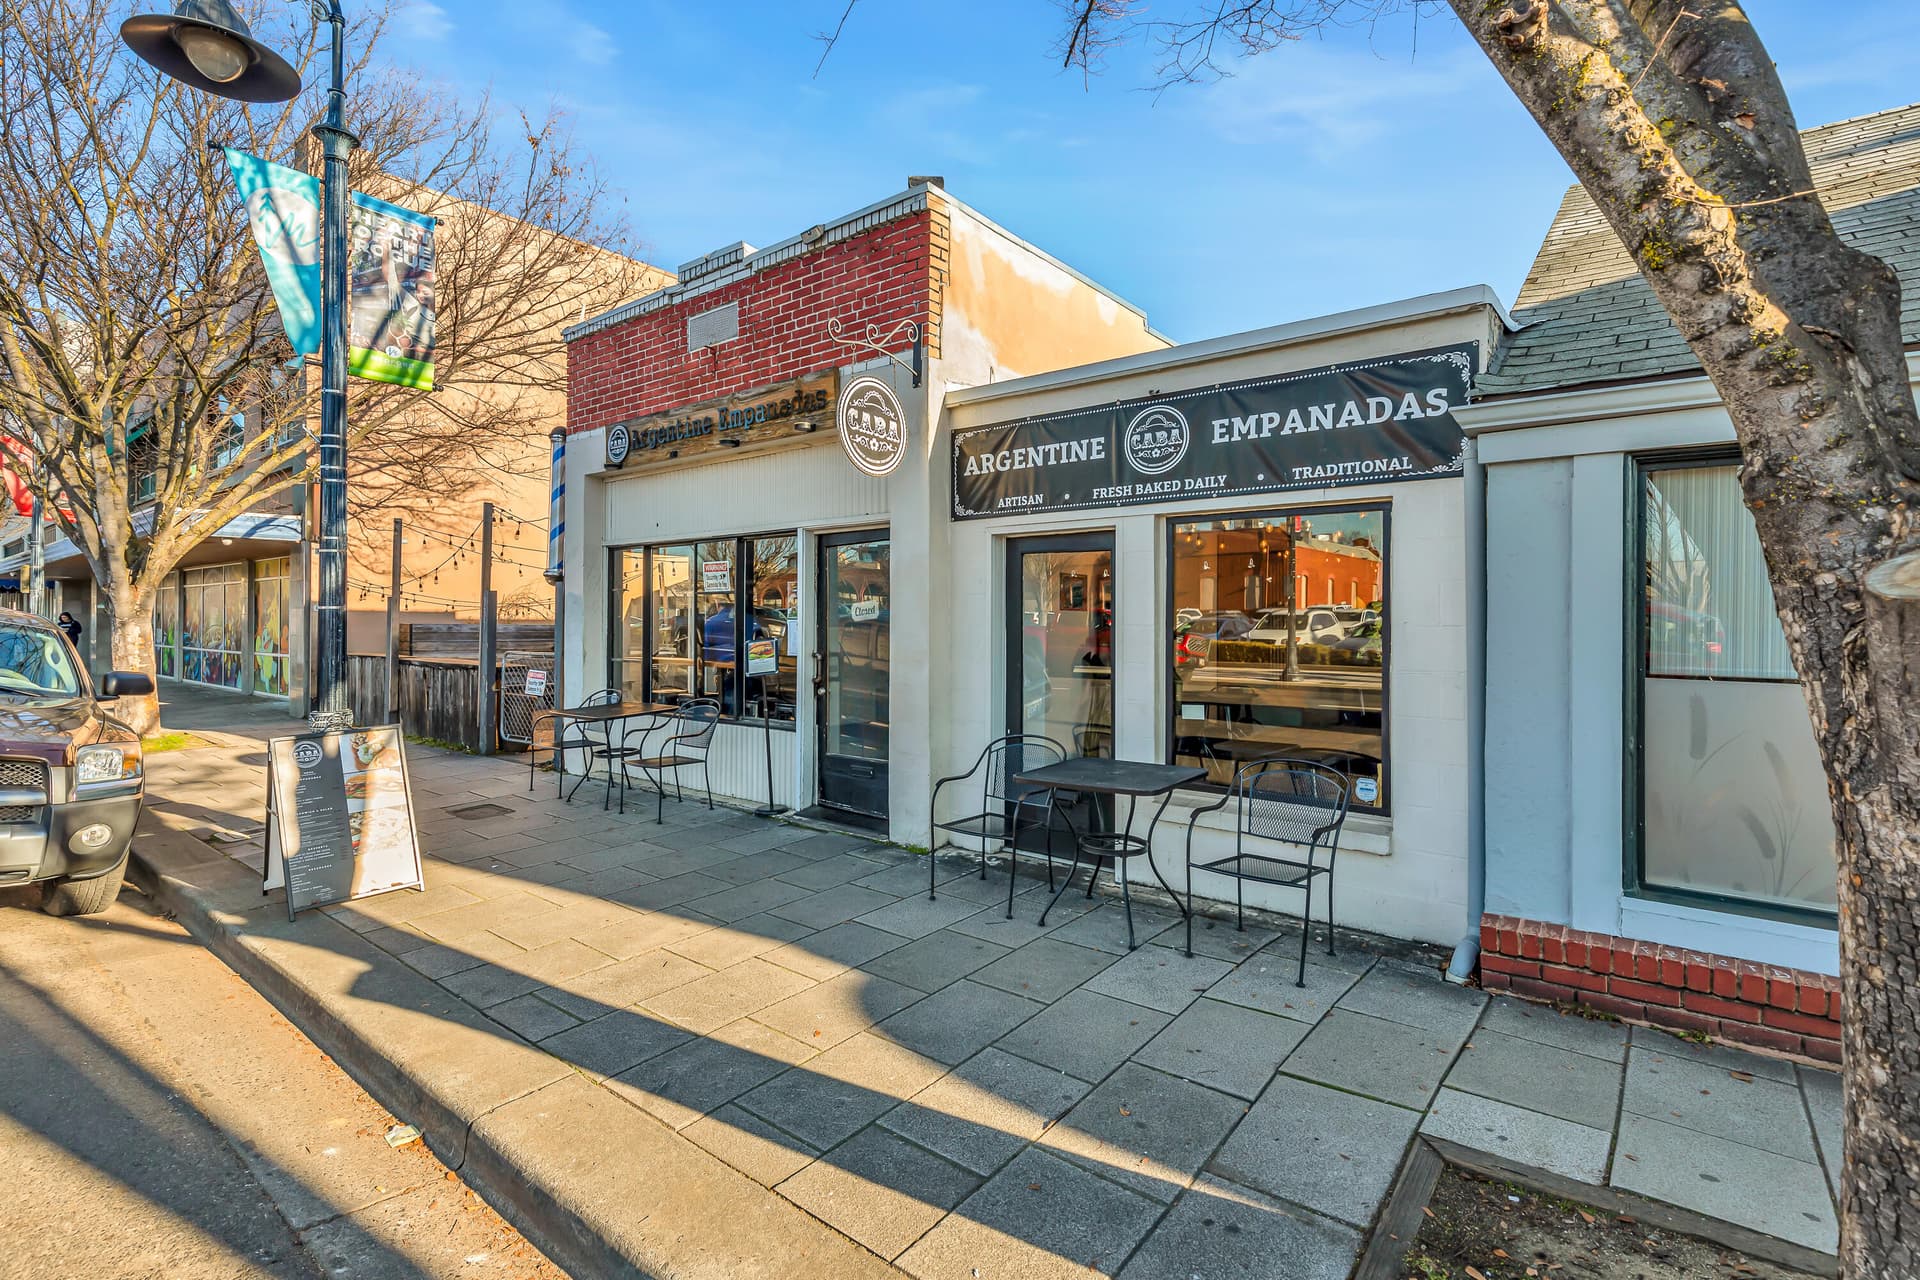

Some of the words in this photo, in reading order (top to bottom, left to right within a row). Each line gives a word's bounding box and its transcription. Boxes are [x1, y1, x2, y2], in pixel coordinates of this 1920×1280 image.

[352, 207, 433, 244] HEART
[353, 225, 386, 242] OF
[391, 236, 432, 259] THE
[352, 238, 433, 271] ROGUE
[631, 416, 713, 450] Argentine
[717, 389, 829, 431] Empanadas
[847, 407, 900, 443] CABA
[1211, 387, 1449, 444] EMPANADAS
[963, 437, 1105, 477] ARGENTINE
[1131, 429, 1183, 450] CABA
[998, 494, 1044, 508] ARTISAN
[1092, 485, 1133, 499] FRESH
[1135, 479, 1181, 495] BAKED
[1184, 474, 1227, 491] DAILY
[1292, 456, 1412, 480] TRADITIONAL
[704, 563, 727, 571] WARNING
